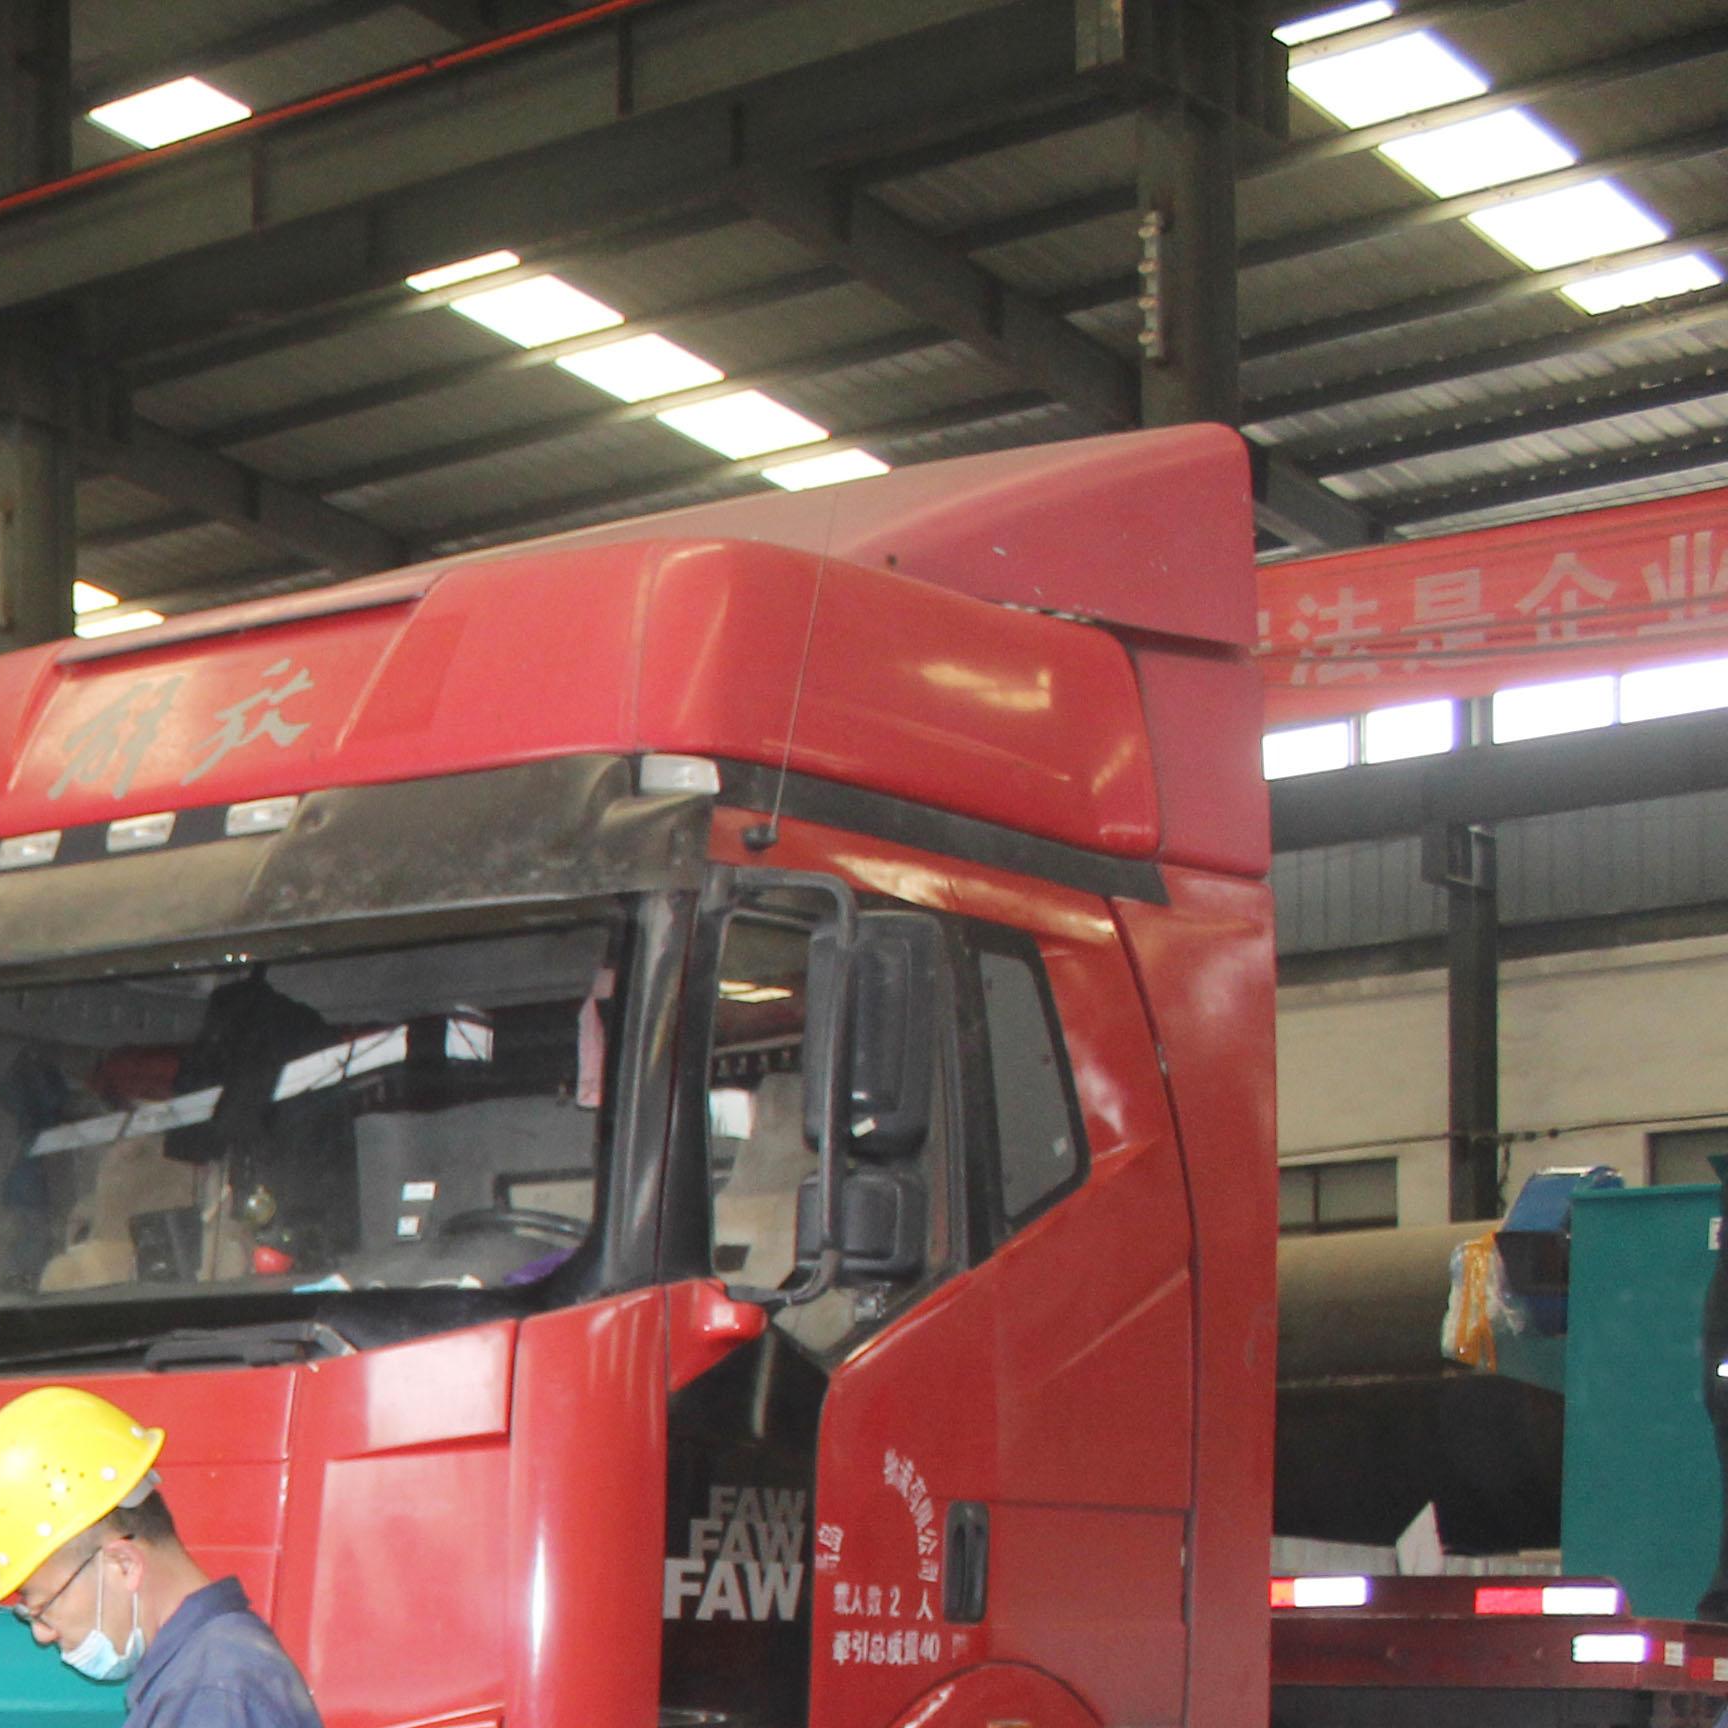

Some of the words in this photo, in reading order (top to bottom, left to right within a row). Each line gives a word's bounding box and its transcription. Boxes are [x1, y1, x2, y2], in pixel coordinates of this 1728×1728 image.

[1250, 530, 1728, 686] 法是企业
[709, 1486, 807, 1521] FAW
[689, 1519, 806, 1561] FAW
[663, 1557, 804, 1621] FAW
[889, 1585, 901, 1617] 2
[916, 1588, 934, 1621] 人
